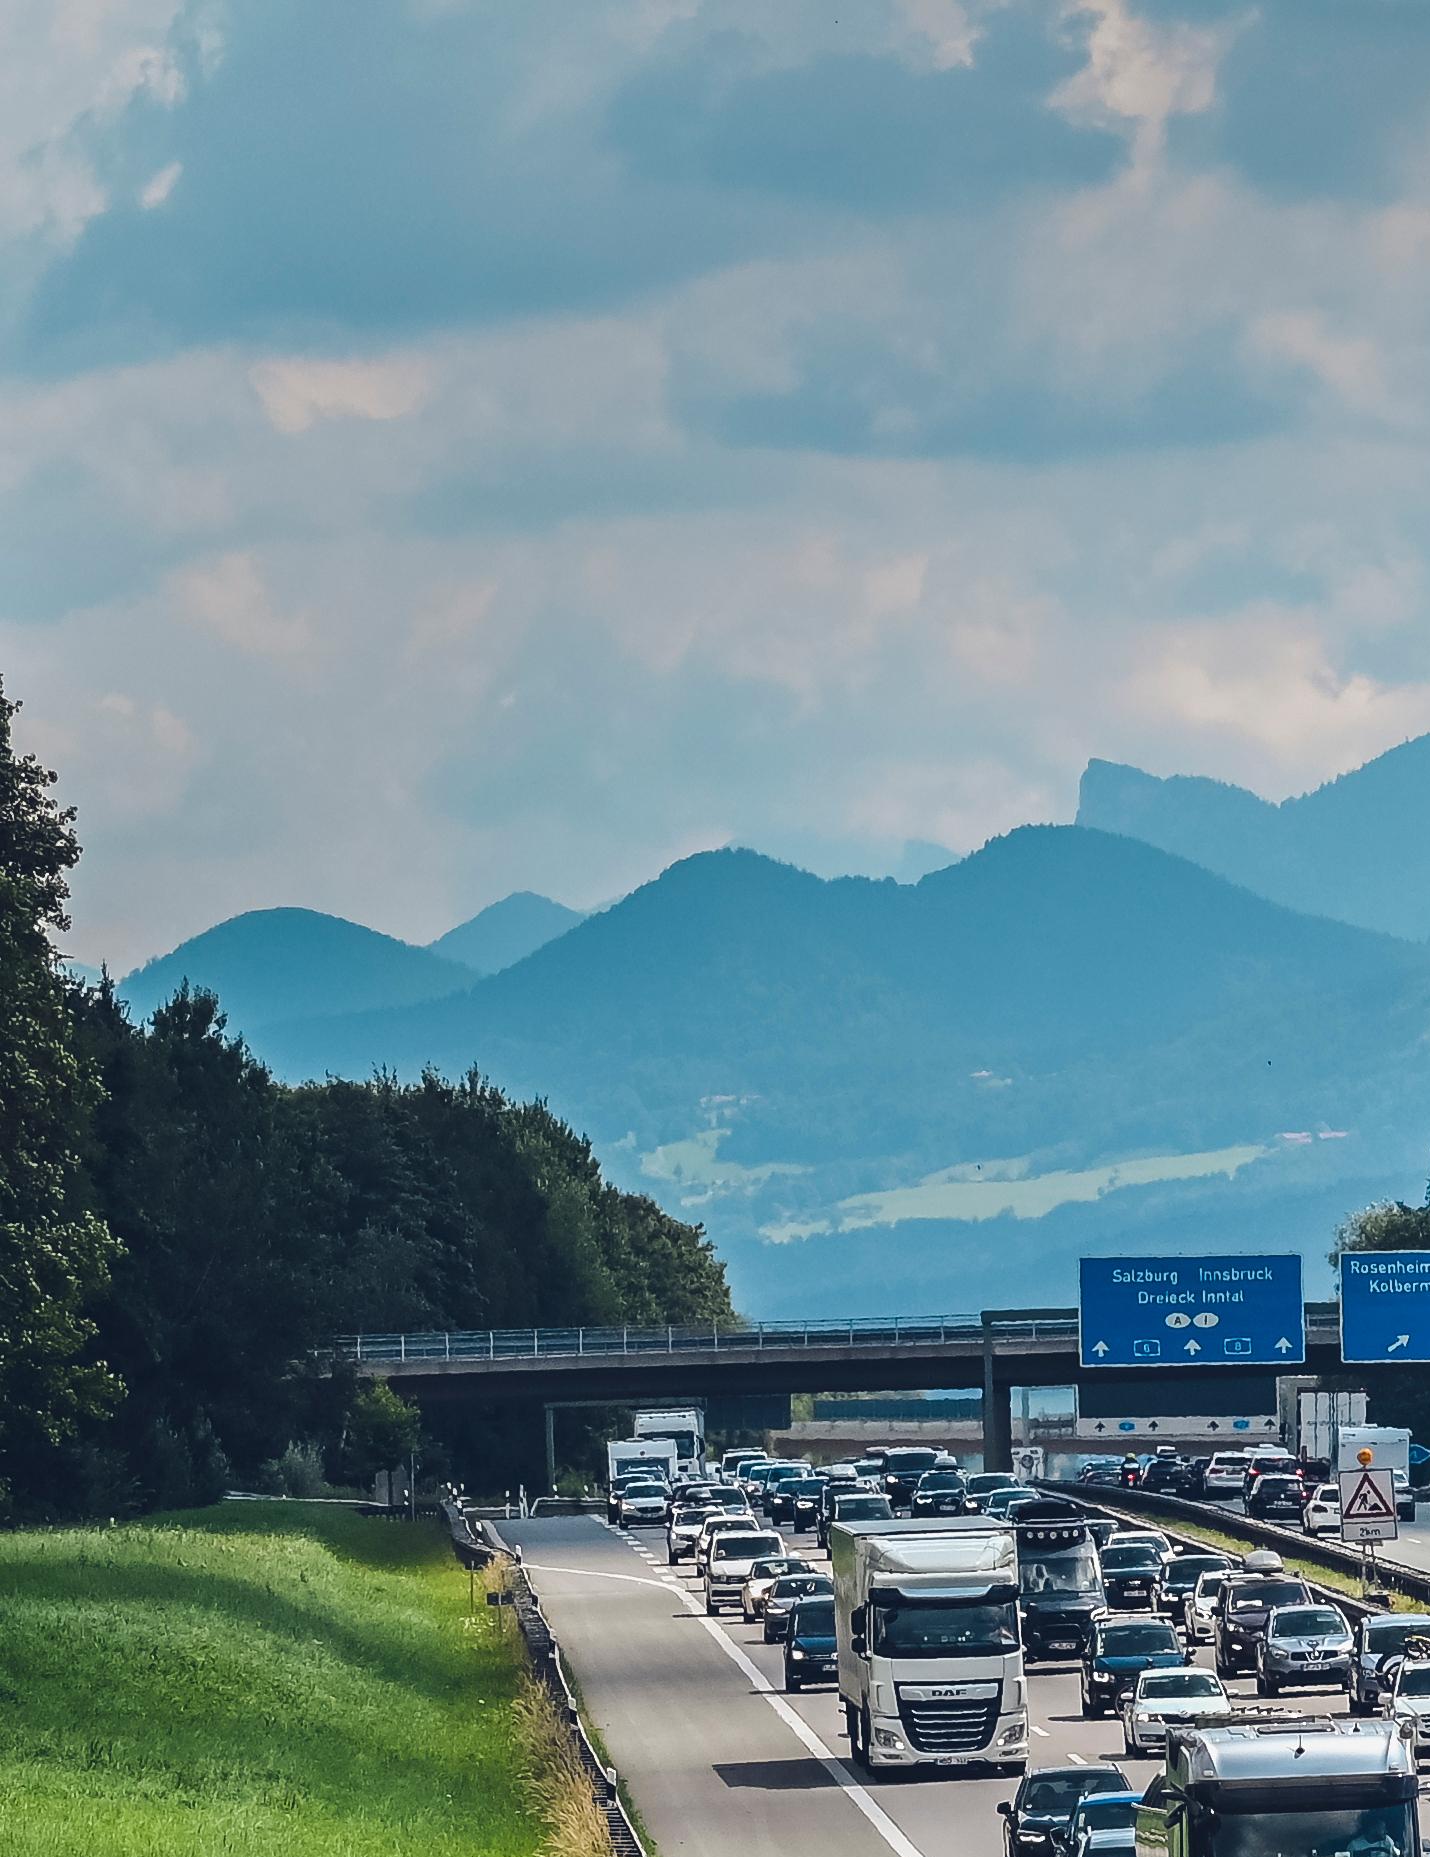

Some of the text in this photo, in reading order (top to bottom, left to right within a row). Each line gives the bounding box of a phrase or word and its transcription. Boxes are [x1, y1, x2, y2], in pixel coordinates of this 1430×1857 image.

[1112, 1266, 1273, 1286] Salzburg Innsbruck
[1137, 1289, 1245, 1305] Dreieck Inntal
[1174, 1315, 1182, 1325] A
[931, 1688, 967, 1697] DAF
